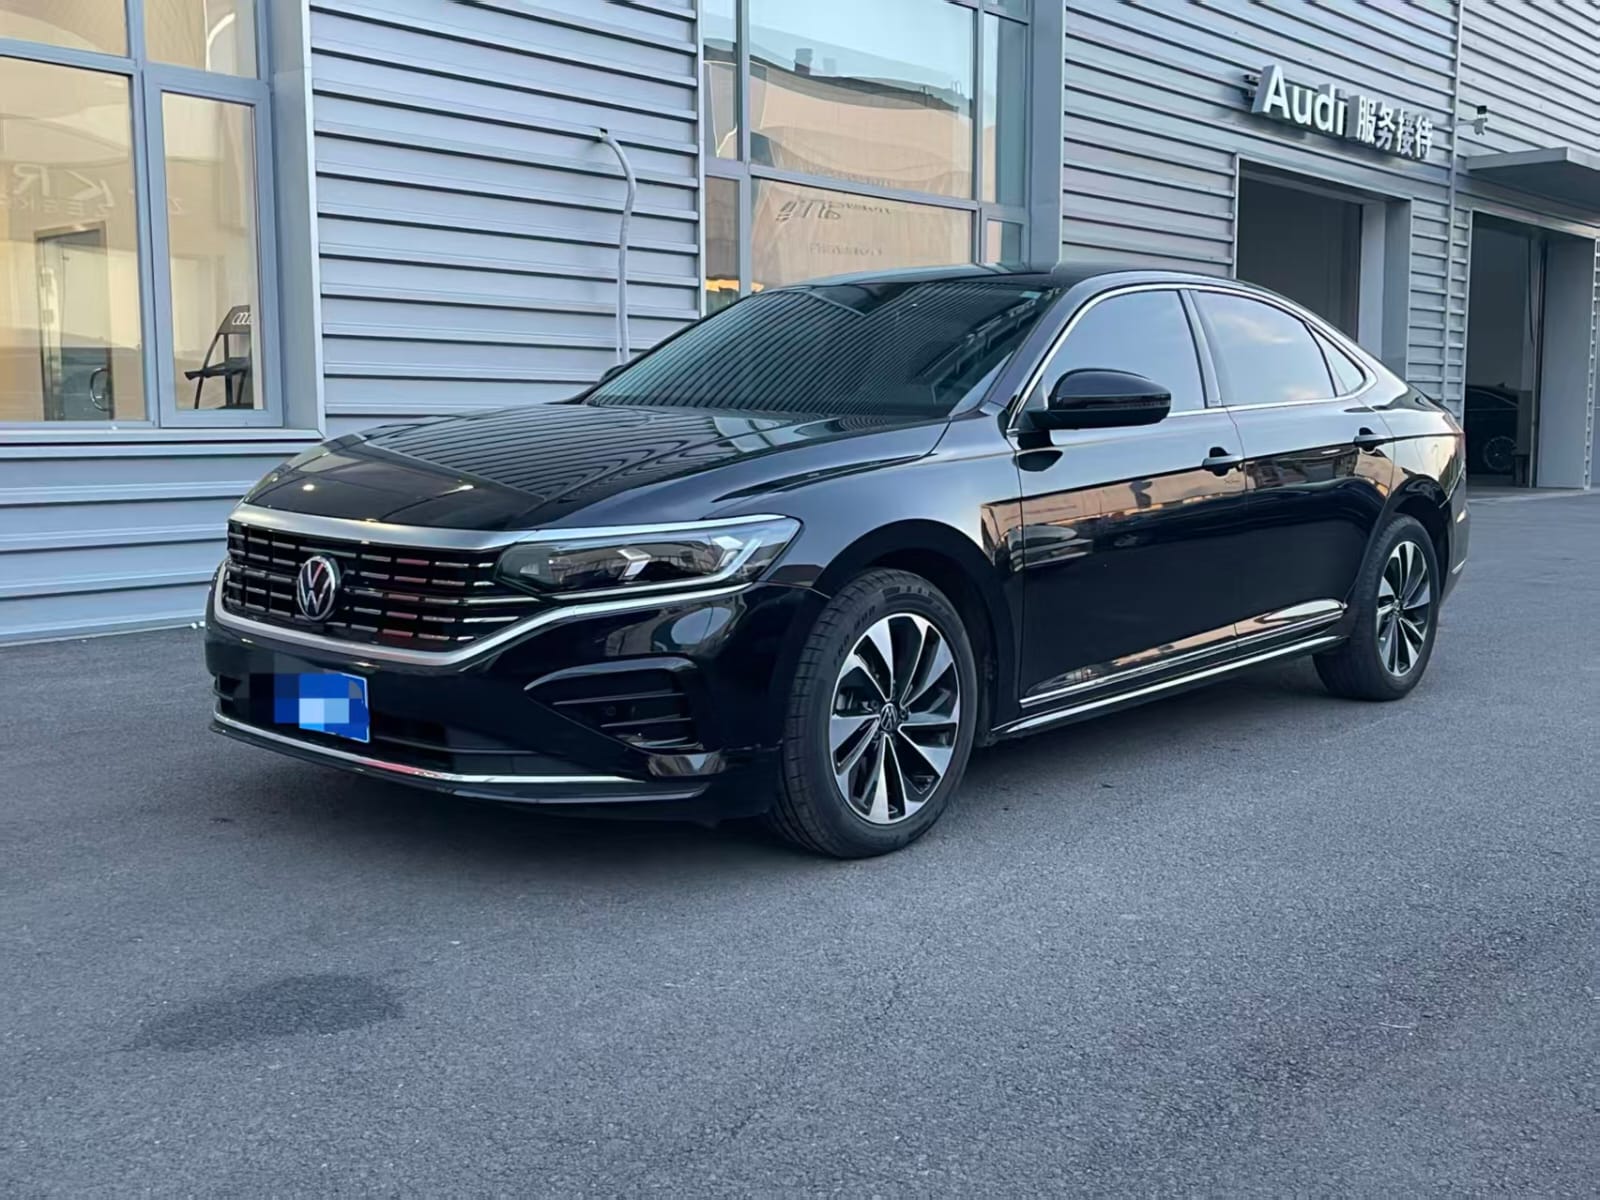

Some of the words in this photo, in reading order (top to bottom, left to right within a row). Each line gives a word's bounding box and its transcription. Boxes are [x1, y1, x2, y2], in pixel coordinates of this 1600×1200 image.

[1260, 64, 1345, 136] Audi
[1355, 95, 1434, 159] 服务接待
